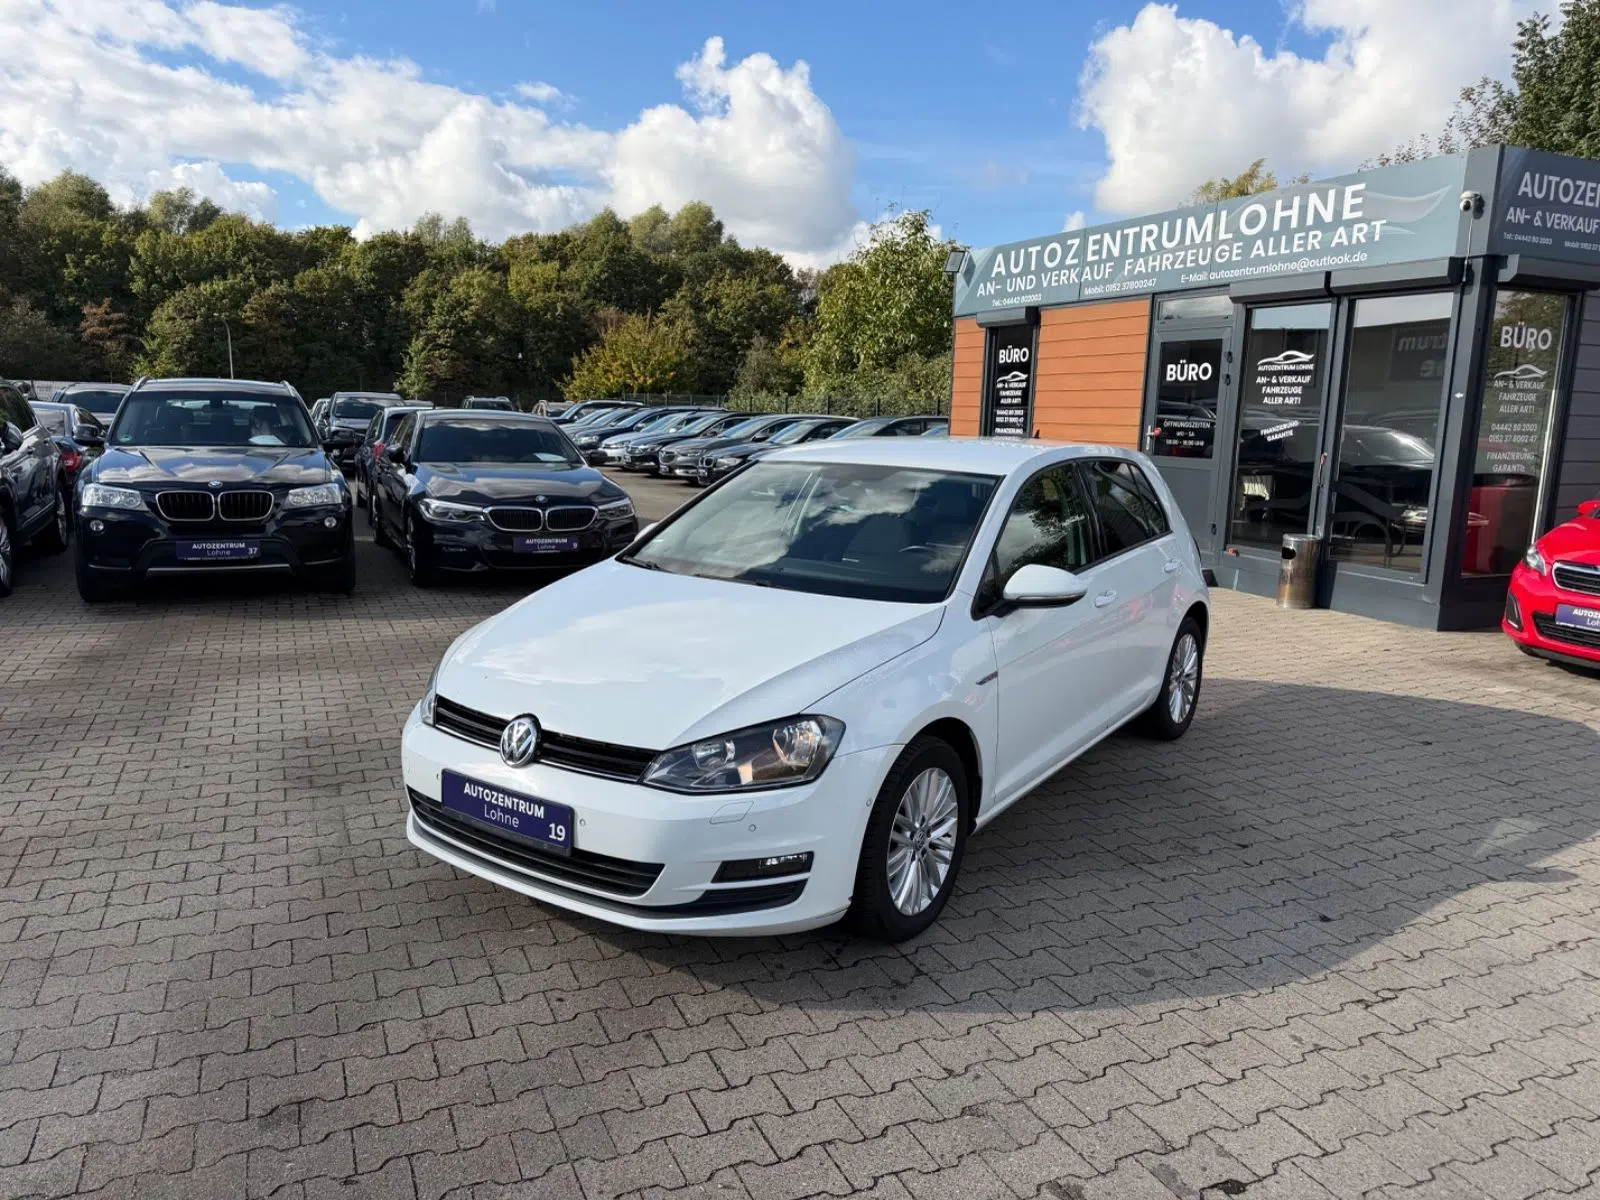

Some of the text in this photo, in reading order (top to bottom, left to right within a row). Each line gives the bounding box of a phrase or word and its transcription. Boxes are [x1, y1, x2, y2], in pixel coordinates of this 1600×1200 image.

[1506, 206, 1600, 234] AN- & VERKAUF
[976, 219, 1387, 297] AN- UND VERKAUF FAHRZEUGE ALLER ART
[1500, 321, 1553, 350] BÜRO
[998, 344, 1030, 363] BÜRO
[1166, 359, 1212, 382] BÜRO
[1255, 375, 1312, 384] AN- & VERKAUF
[1262, 386, 1303, 395] FAHRZEUGE
[1263, 396, 1283, 405] ALLER
[192, 542, 246, 550] AUTOZENTRUM
[247, 547, 258, 555] 37
[463, 782, 545, 819] AUTOZENTRUM
[484, 804, 520, 828] Lohne
[548, 823, 566, 841] 19
